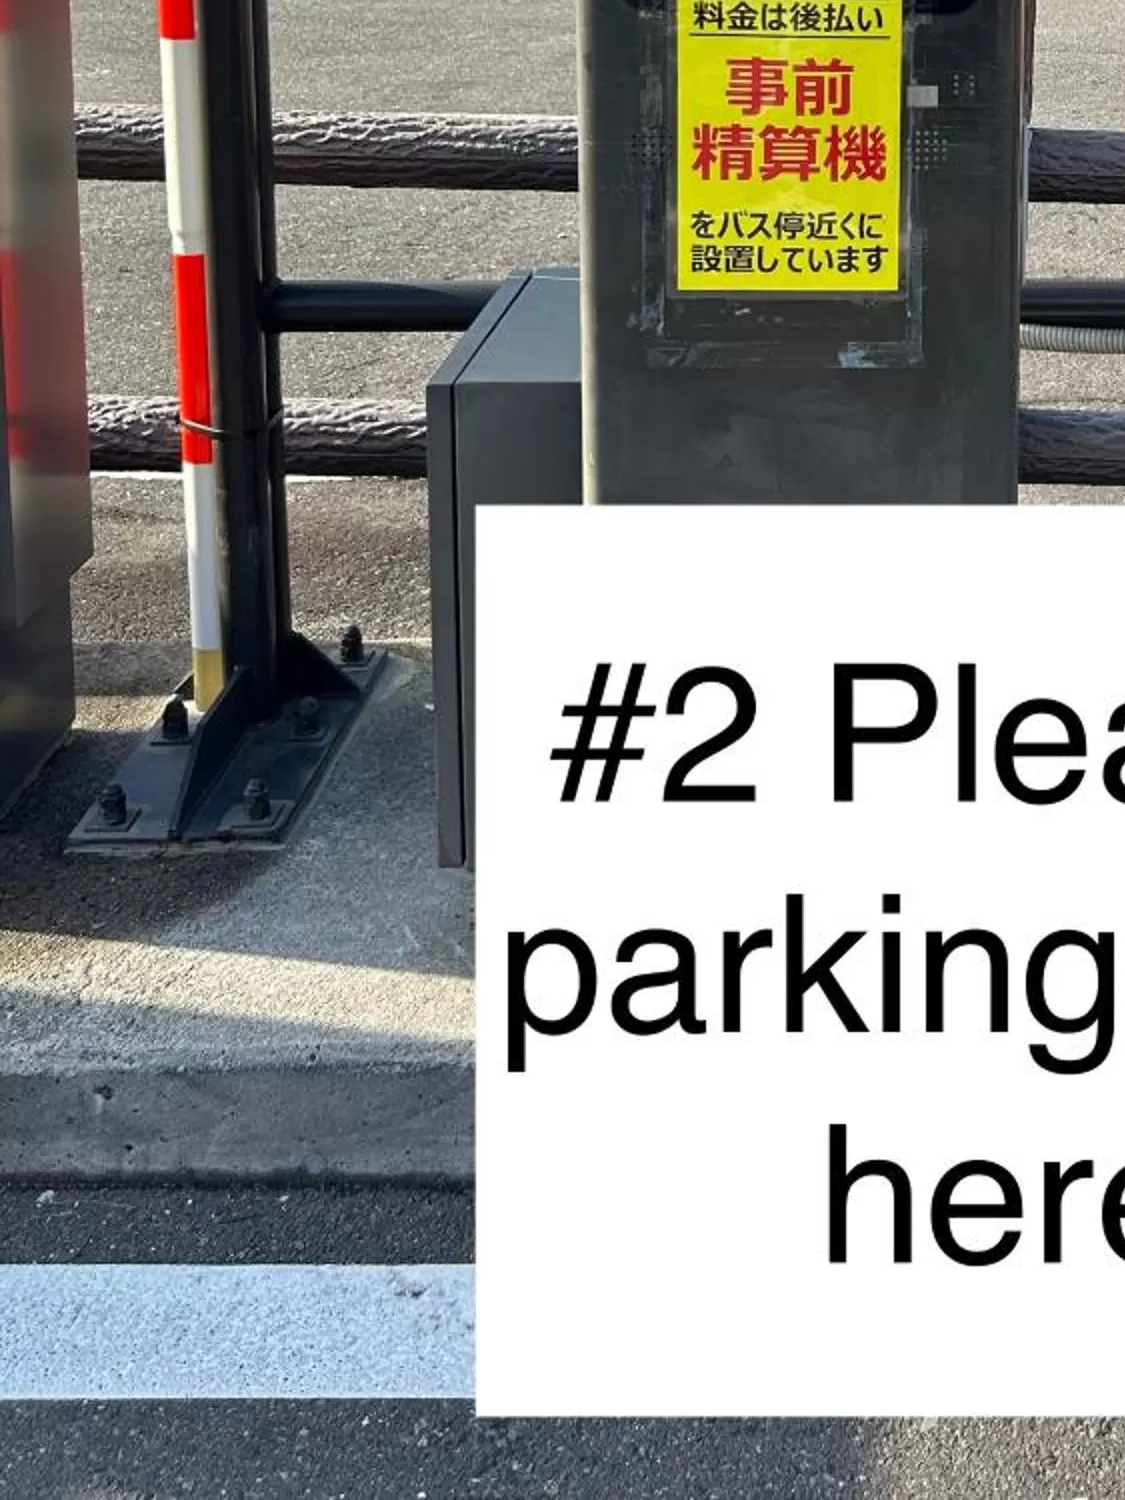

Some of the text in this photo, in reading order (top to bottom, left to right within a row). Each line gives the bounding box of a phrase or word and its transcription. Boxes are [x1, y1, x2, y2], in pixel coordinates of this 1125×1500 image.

[693, 1, 883, 32] 料金は後払い
[725, 56, 855, 117] 事前
[691, 123, 887, 183] 精算機
[691, 210, 883, 241] をバス停近くに
[691, 244, 889, 274] 設置しています
